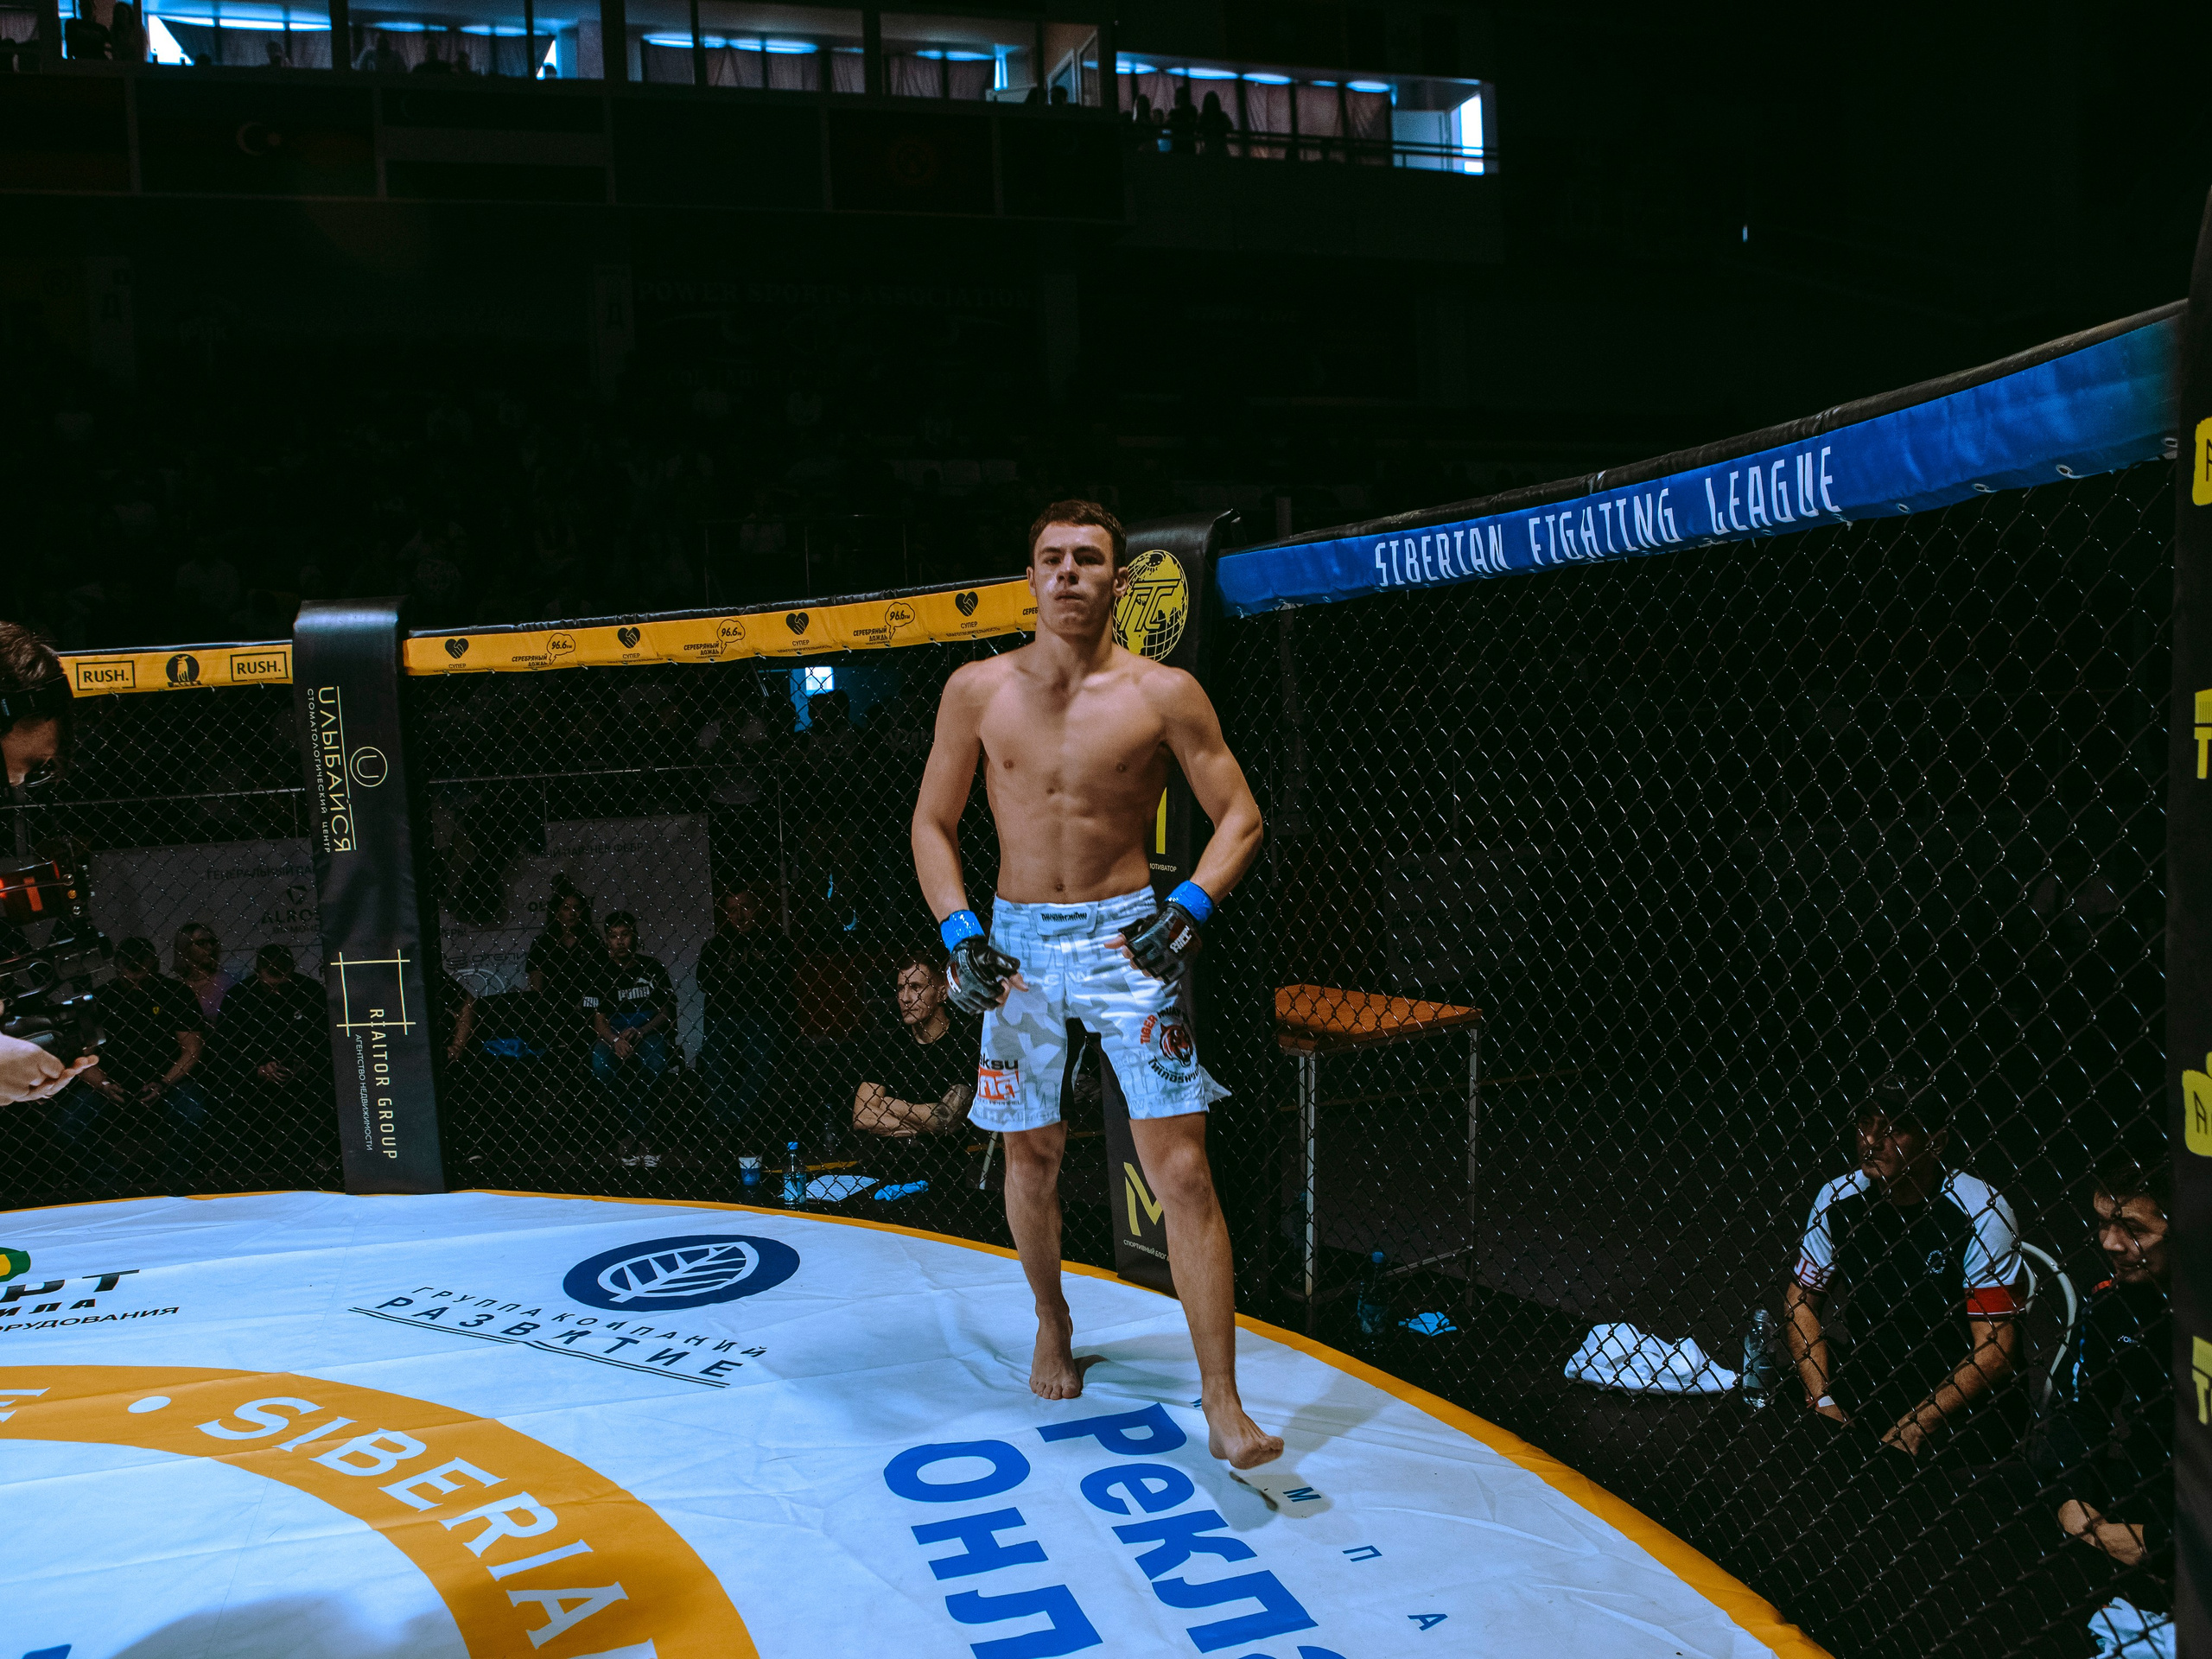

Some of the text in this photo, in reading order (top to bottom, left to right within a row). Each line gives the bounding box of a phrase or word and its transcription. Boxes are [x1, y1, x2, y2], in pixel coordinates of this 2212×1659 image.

[1374, 446, 1844, 588] SIBERIAN FIGHTING LEAGUE
[683, 640, 720, 651] СЕРЕБРЯНЫЙ
[854, 625, 887, 637] СЕРЕБРЯНЫЙ
[237, 660, 282, 674] RUSH.
[512, 652, 548, 662] СЕРЕБРЯНЫЙ
[84, 670, 130, 683] RUSH.
[307, 688, 330, 853] СТОМАТОЛОГИЧЕСКИЙ ЦЕНТР
[1141, 1014, 1158, 1045] TIGER
[355, 1034, 373, 1151] АГЕНТСТВО НЕДВИЖИМОСТИ
[378, 1098, 397, 1159] GROUP
[1123, 1239, 1167, 1261] СПОРТИВНЫЙ БЛОГ
[0, 1306, 180, 1332] РУДОВАНИЯ
[411, 1286, 766, 1359] ГРУППА КОМПАНИЙ
[374, 1296, 743, 1379] РАЗВИТИЕ
[1036, 1402, 1348, 1659] Рекл
